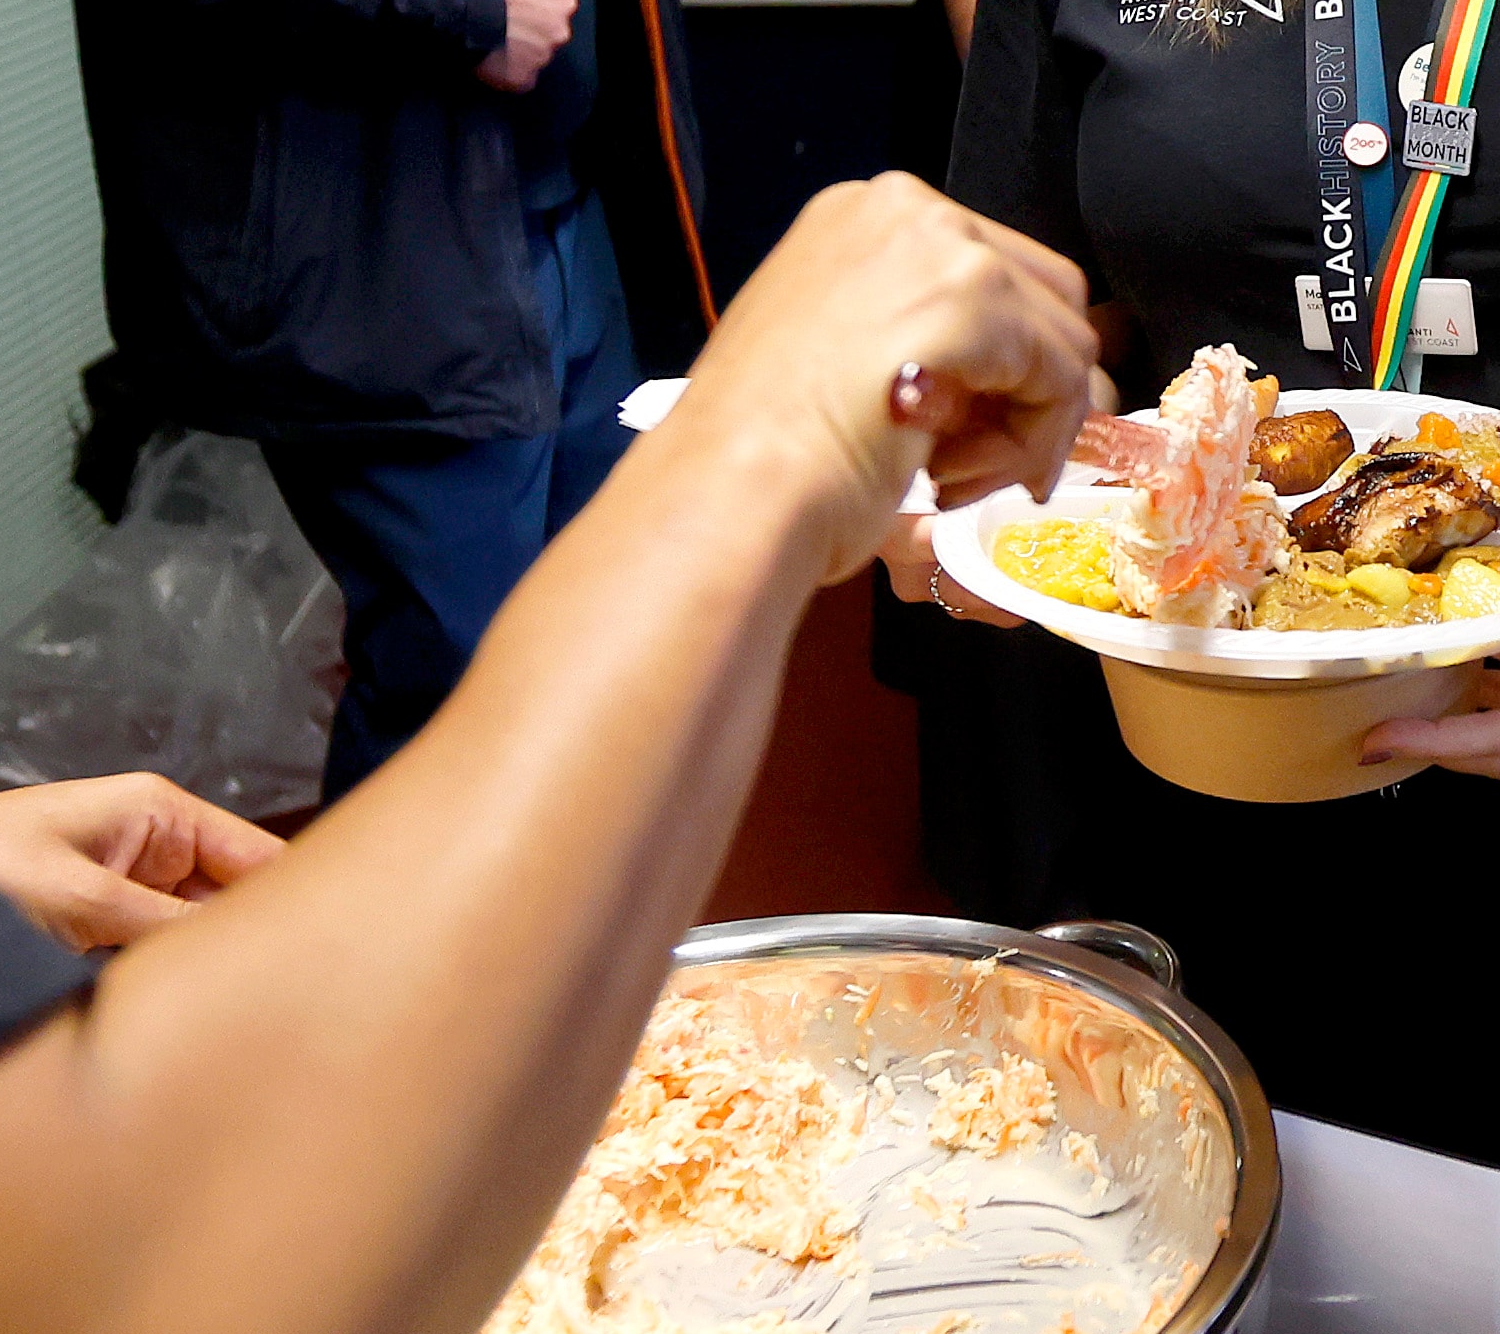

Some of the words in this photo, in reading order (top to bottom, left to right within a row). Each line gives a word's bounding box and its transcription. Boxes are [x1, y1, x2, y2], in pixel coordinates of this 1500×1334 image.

[1118, 4, 1172, 25] WEST
[1176, 5, 1248, 27] COAST
[1411, 104, 1470, 132] BLACK
[1407, 139, 1467, 164] MONTH
